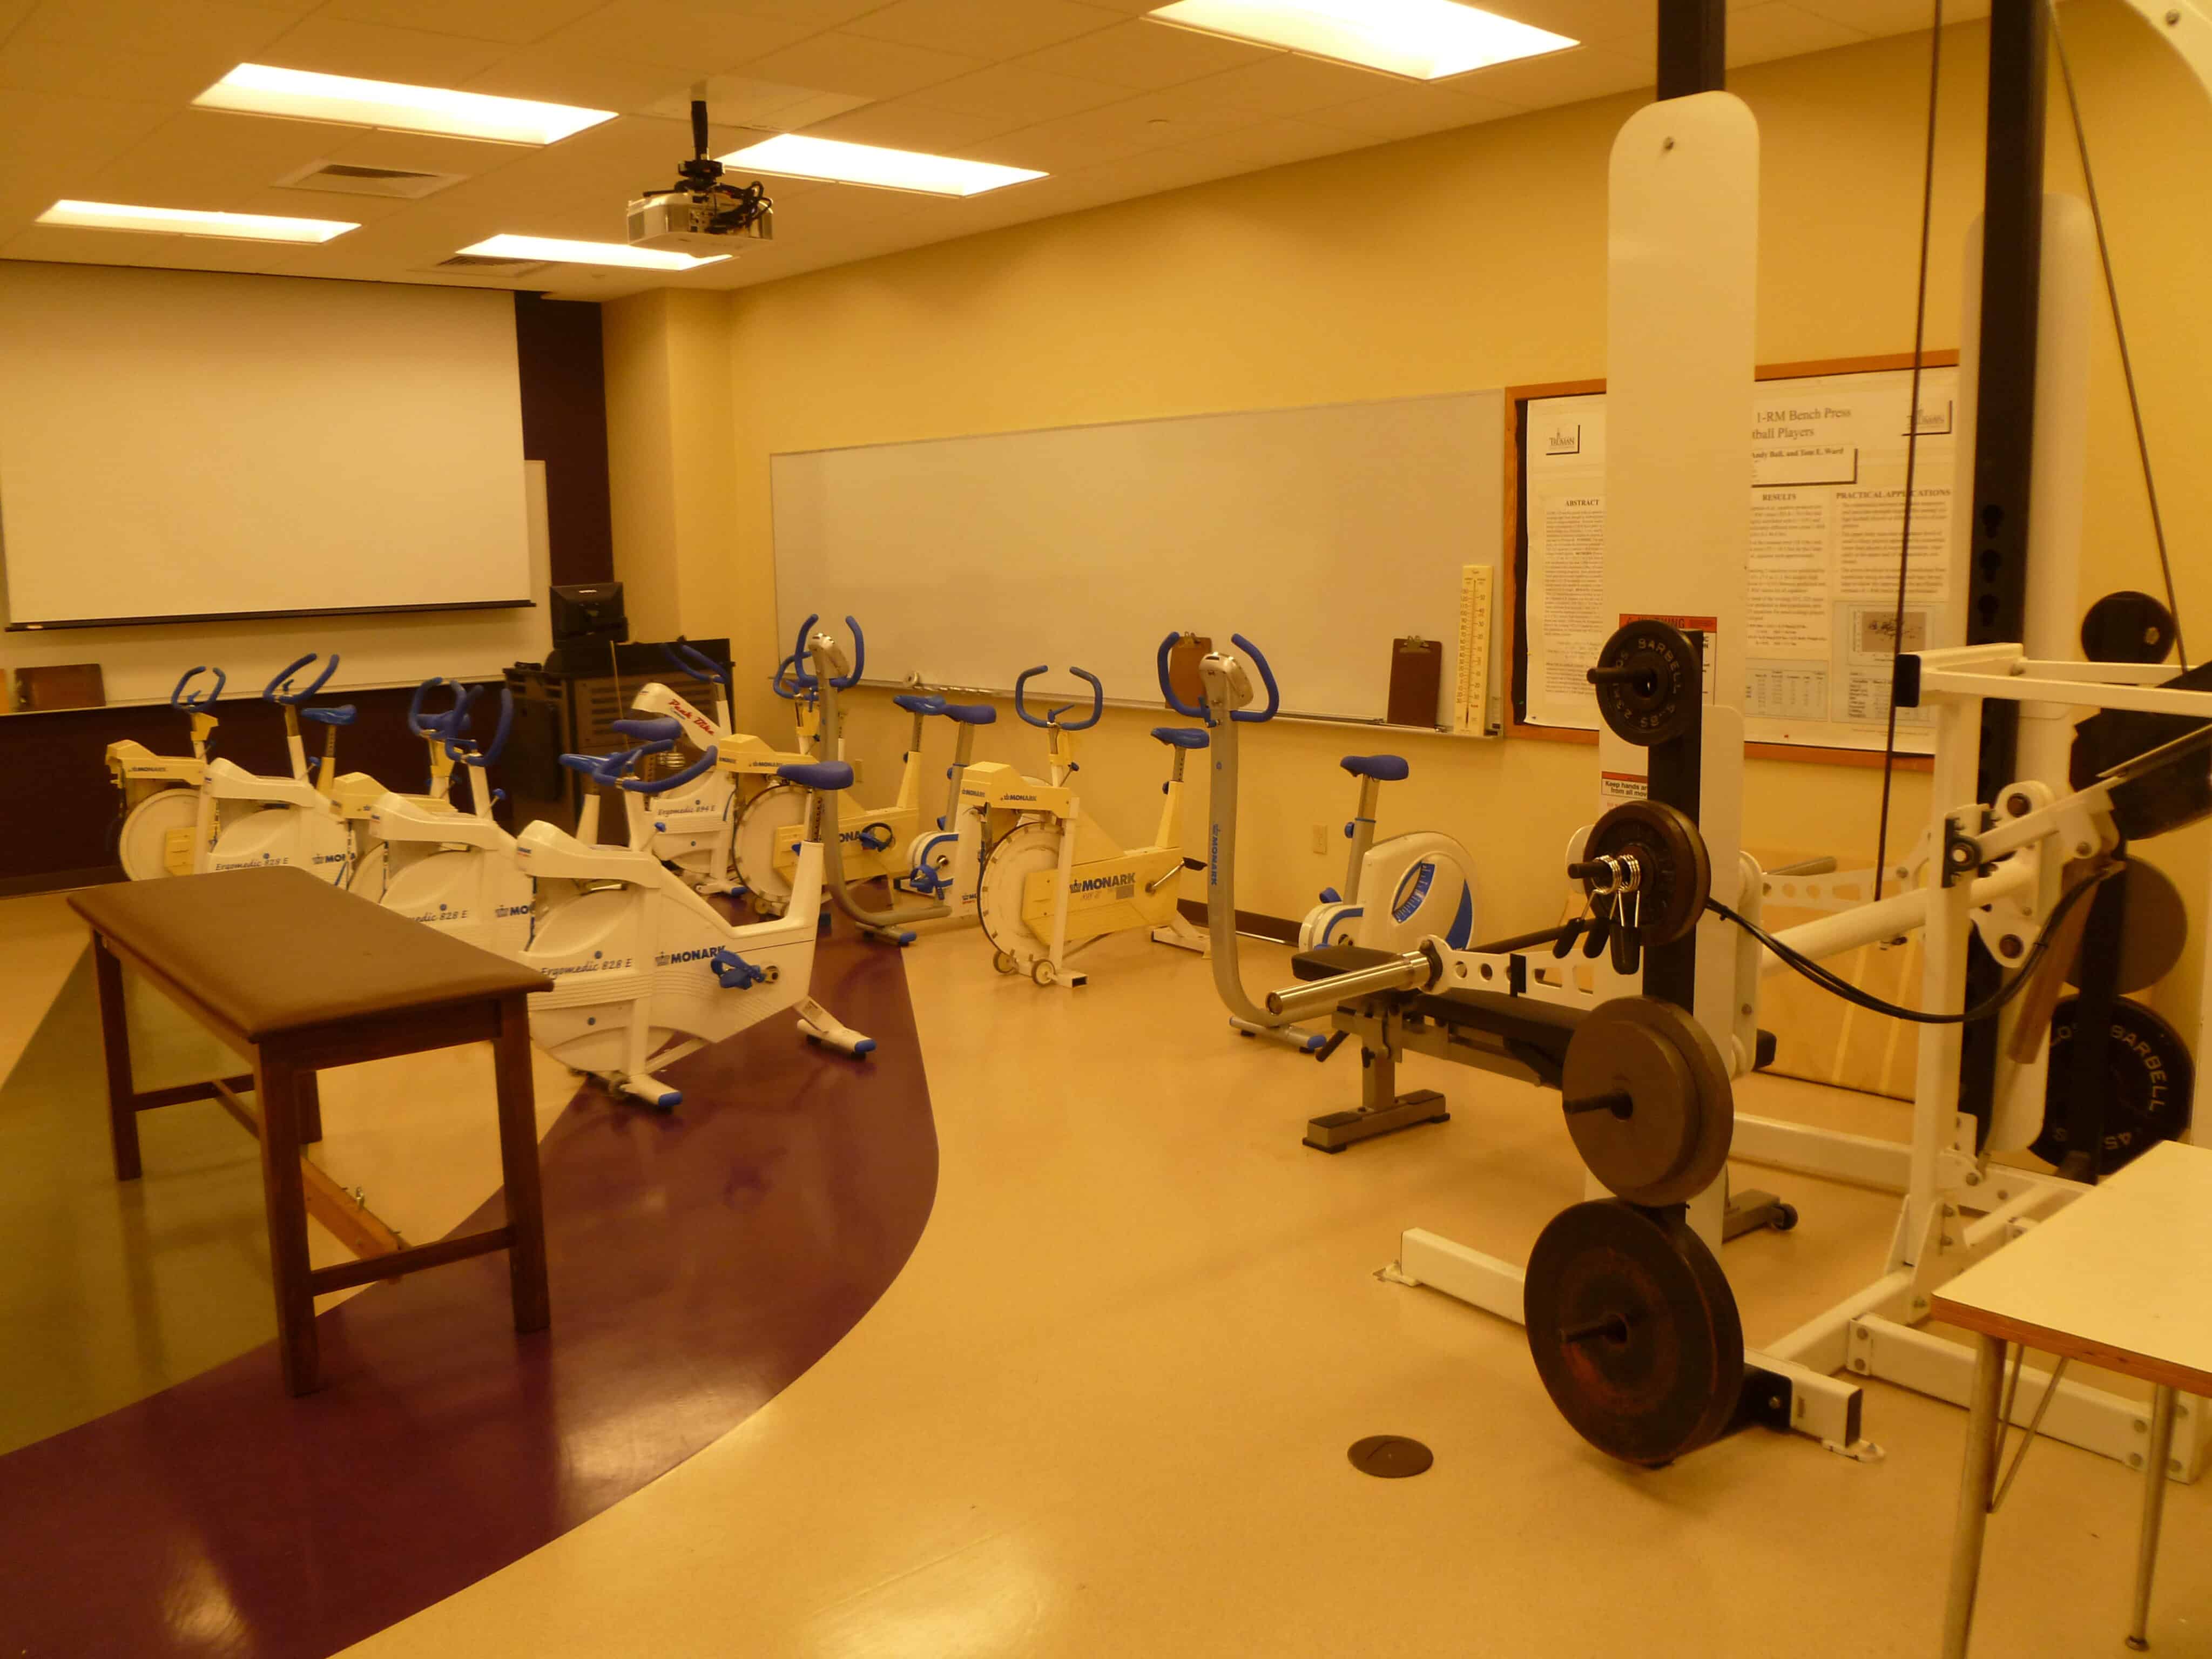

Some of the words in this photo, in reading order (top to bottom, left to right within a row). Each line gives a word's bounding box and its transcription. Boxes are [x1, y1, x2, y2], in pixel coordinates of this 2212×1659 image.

[1757, 410, 1786, 423] 1-RM
[1789, 408, 1821, 421] Bench
[1825, 407, 1851, 419] Press
[1777, 427, 1815, 440] Players
[1762, 493, 1797, 501] RESULTS
[1637, 638, 1681, 694] BARBELL
[668, 698, 693, 719] Peak
[693, 717, 715, 736] Bike
[1605, 780, 1620, 788] Keep
[1621, 781, 1640, 790] hands
[215, 859, 261, 871] Ergomedic
[282, 857, 289, 865] E
[1210, 836, 1218, 886] MONARK
[1082, 872, 1136, 892] MONARK
[439, 911, 460, 921] 828
[461, 909, 468, 919] E
[541, 961, 599, 980] Ergomedic
[601, 958, 623, 970] 828
[624, 957, 633, 968] E
[2111, 1025, 2167, 1111] BARBELL
